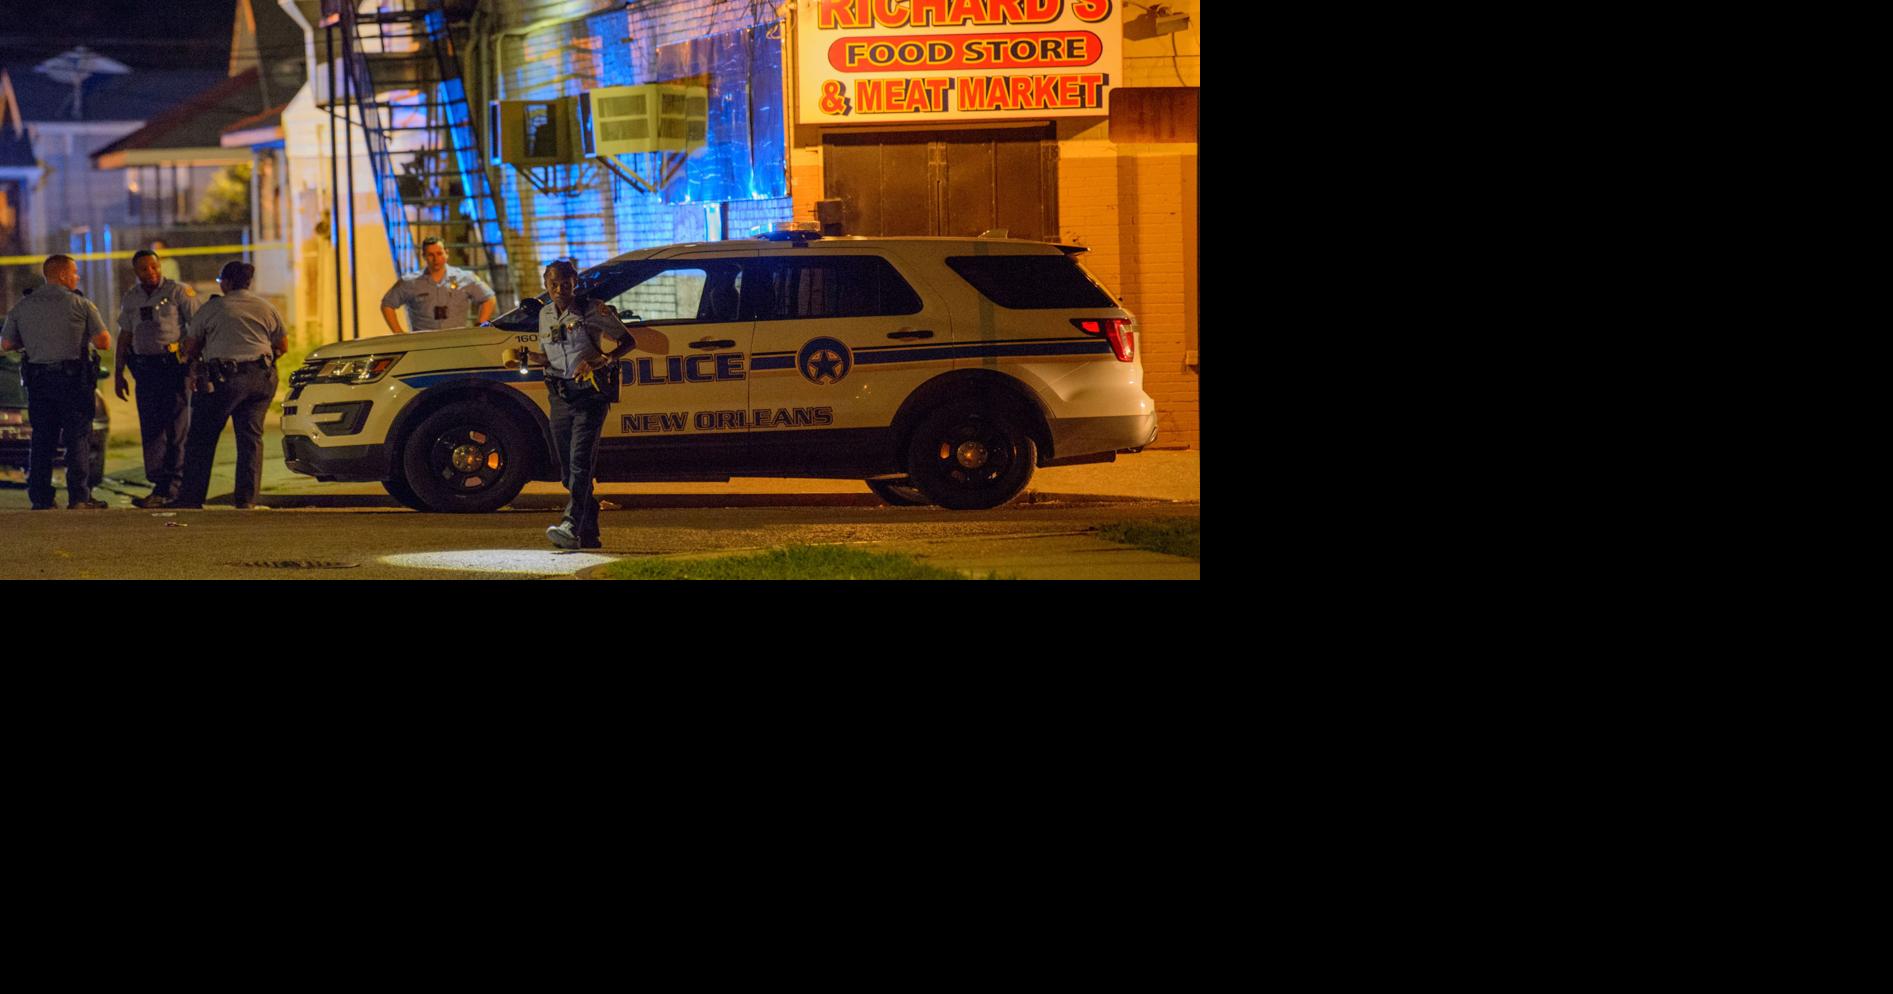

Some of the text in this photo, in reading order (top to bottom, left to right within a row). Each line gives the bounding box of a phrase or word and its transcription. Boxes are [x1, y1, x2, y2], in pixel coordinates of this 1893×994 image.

[818, 0, 1112, 29] RICHARDS
[846, 38, 1086, 67] FOOD STORE
[819, 73, 1108, 116] & MEAT MARKET
[620, 352, 746, 386] OLICE
[621, 407, 833, 433] NEW ORLEANS
